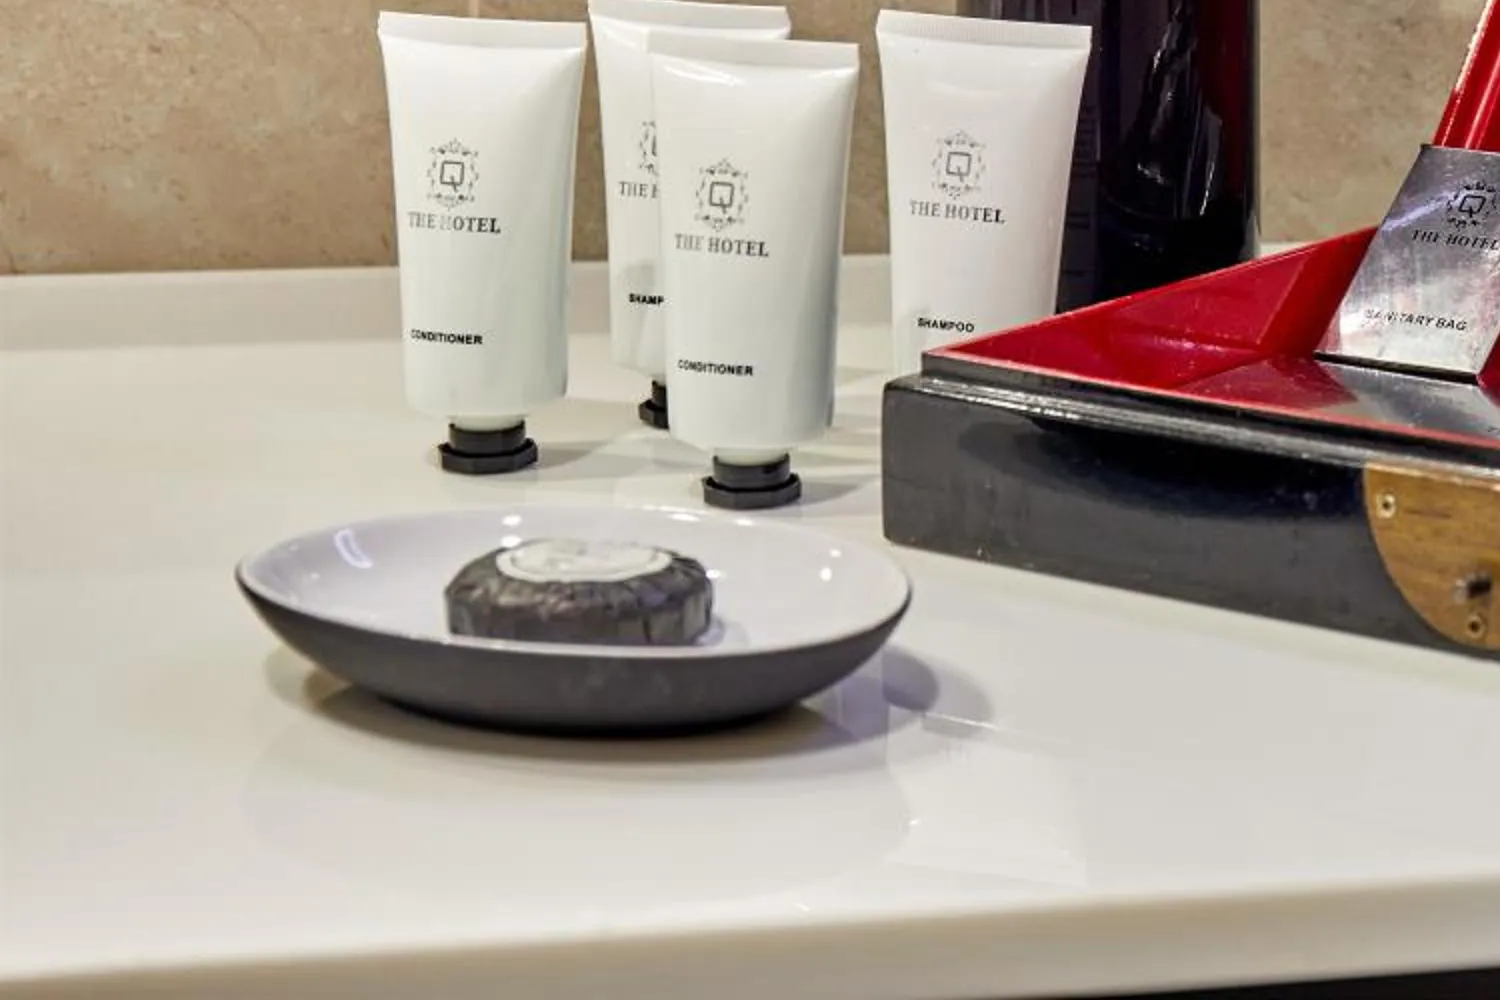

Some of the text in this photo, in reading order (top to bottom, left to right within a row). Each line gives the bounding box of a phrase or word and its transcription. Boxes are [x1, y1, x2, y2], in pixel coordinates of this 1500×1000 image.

[619, 181, 649, 198] THE
[910, 200, 1006, 224] THE HOTEL
[407, 211, 501, 235] THE HOTEL
[675, 233, 769, 257] THE HOTEL
[1412, 229, 1500, 250] THE HOTEL
[629, 293, 665, 307] SHAMP
[917, 317, 975, 333] SHAMPOO
[1364, 308, 1468, 331] SANITARY BAG
[411, 329, 483, 345] CONDITIONER
[678, 359, 753, 377] CONDITIONER
